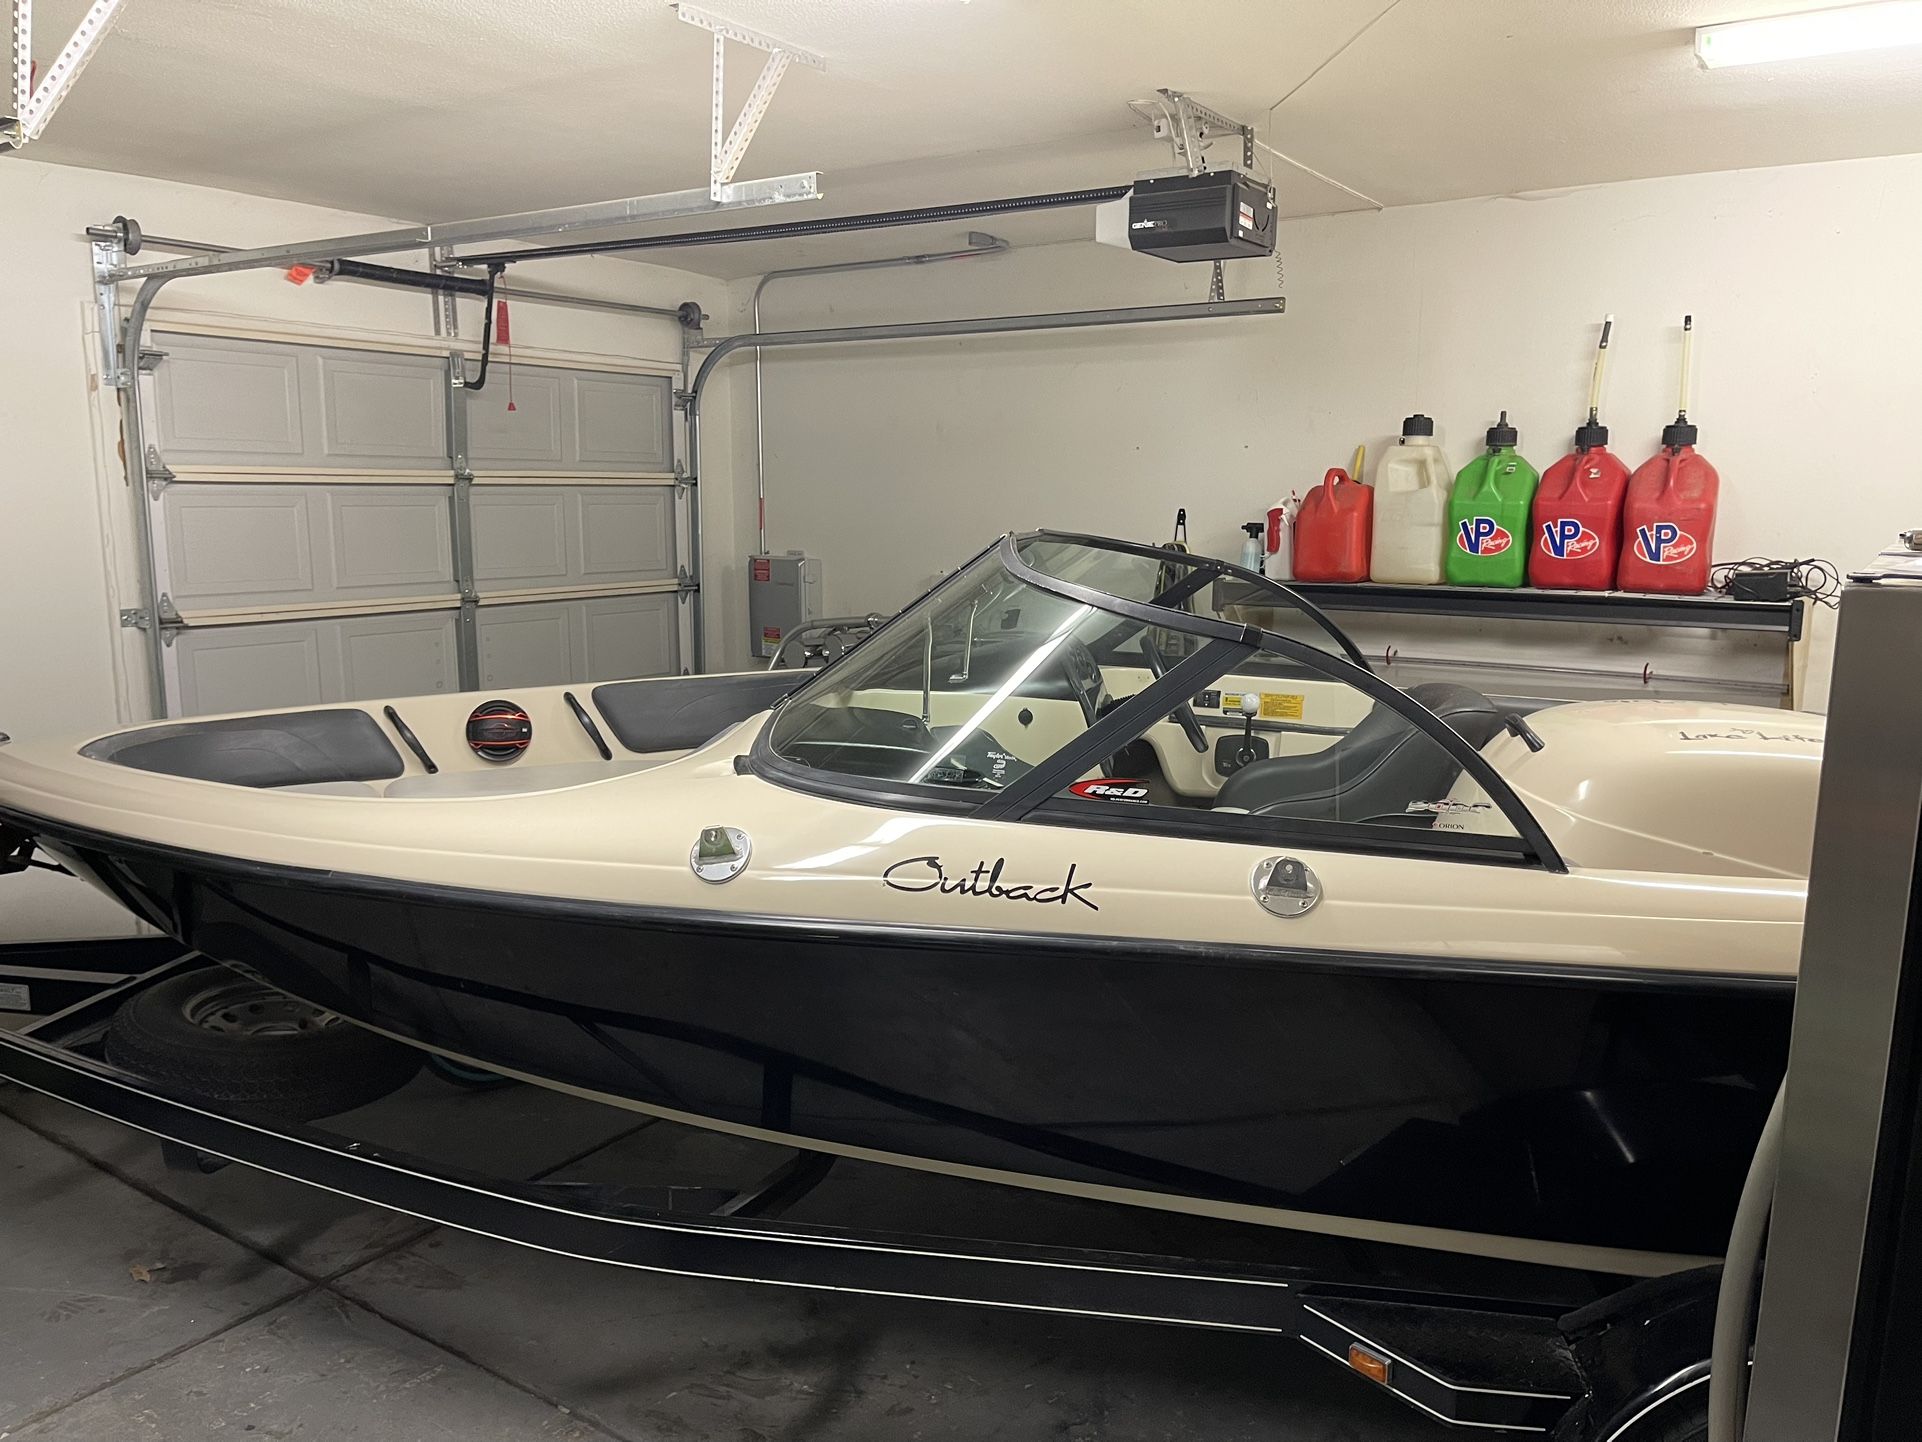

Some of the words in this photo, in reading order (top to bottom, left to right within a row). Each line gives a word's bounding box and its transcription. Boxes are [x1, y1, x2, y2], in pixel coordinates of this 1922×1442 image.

[1459, 516, 1496, 555] VP
[1481, 537, 1511, 551] Racing
[1543, 519, 1582, 559] VP
[1567, 539, 1598, 553] Racing
[1636, 523, 1679, 563] VP
[1663, 544, 1695, 559] Racing
[1083, 784, 1149, 798] R&D
[883, 856, 1099, 912] Outback
